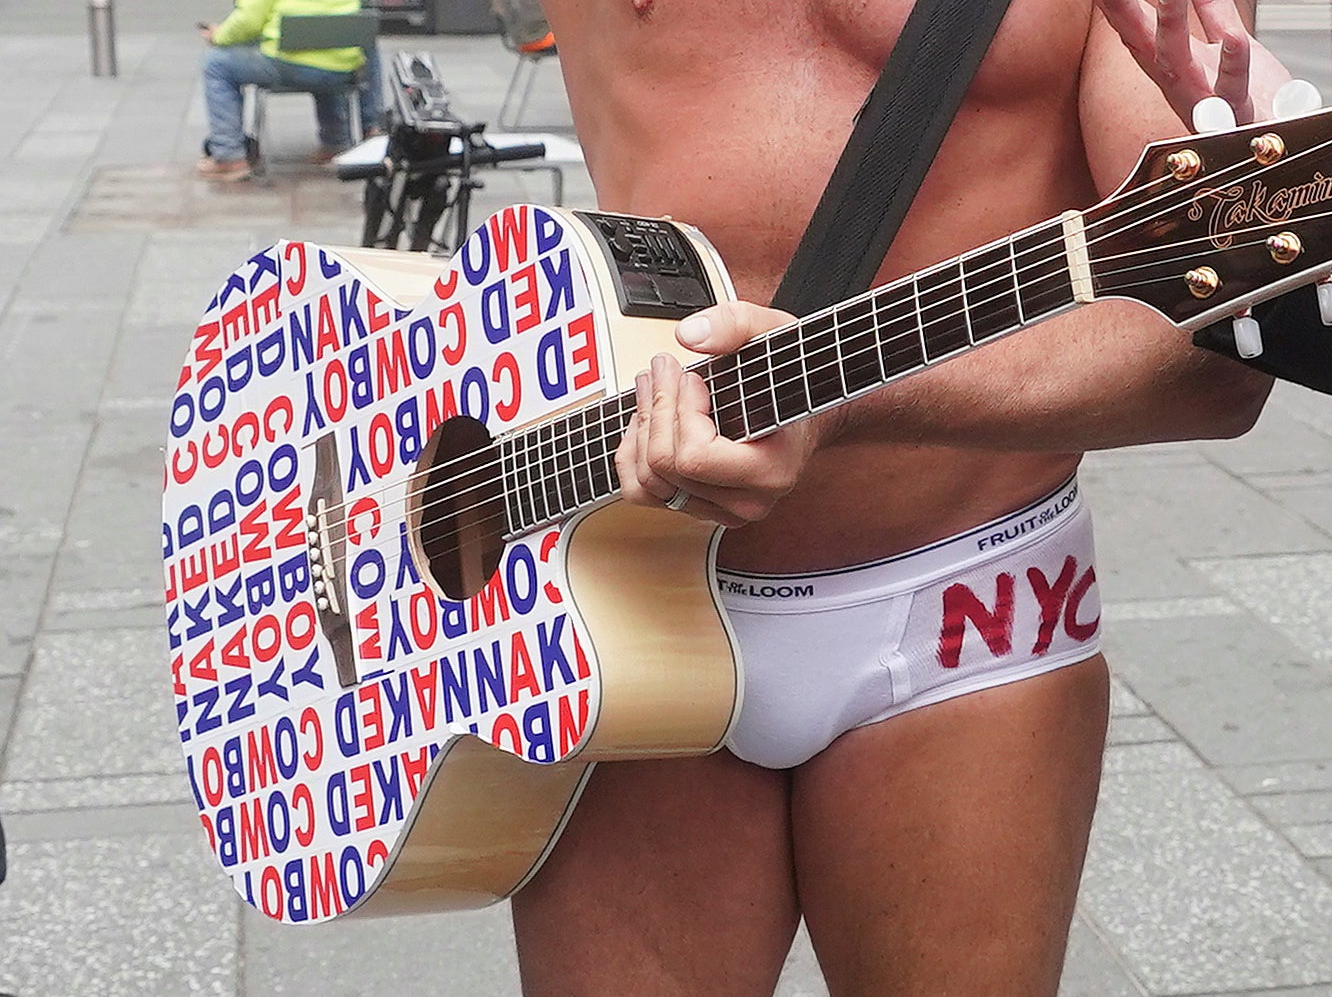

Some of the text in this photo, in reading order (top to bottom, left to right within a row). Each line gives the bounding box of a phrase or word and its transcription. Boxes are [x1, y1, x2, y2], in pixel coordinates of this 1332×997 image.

[290, 278, 413, 371] NAKE
[302, 248, 592, 438] KED COWBOY
[194, 292, 257, 723] NAKED COW
[231, 411, 289, 701] COWBOY
[263, 395, 325, 690] COWBOY
[977, 516, 1037, 551] FRUIT
[177, 503, 223, 735] NAKED
[347, 496, 396, 684] COW
[749, 585, 814, 598] LOOM
[935, 554, 1101, 668] NYC
[334, 649, 473, 759] NAKED
[473, 612, 592, 714] NAK
[469, 689, 590, 764] WBO
[326, 743, 442, 838] AKED
